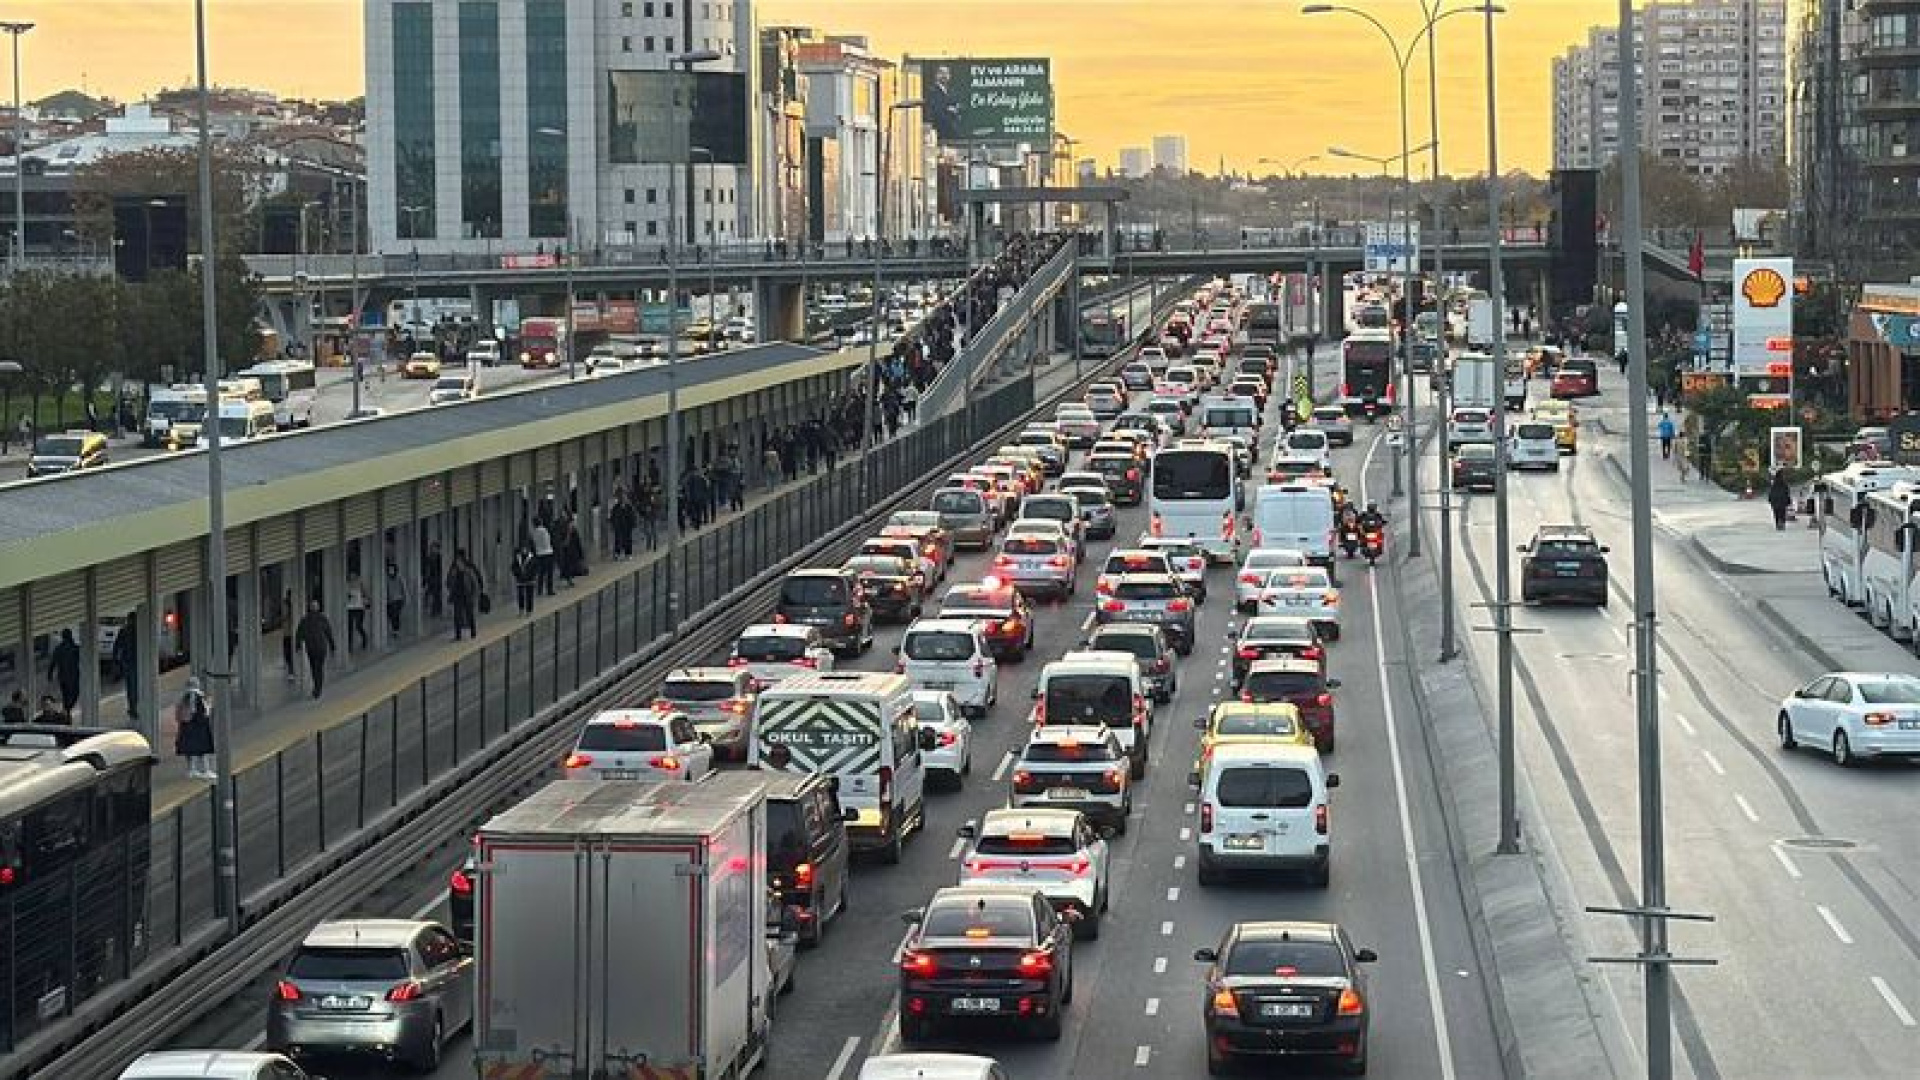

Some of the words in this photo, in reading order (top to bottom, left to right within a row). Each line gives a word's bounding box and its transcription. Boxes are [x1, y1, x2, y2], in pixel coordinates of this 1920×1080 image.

[970, 65, 985, 75] EV
[1004, 65, 1044, 75] ARABA
[768, 732, 813, 743] OKUL
